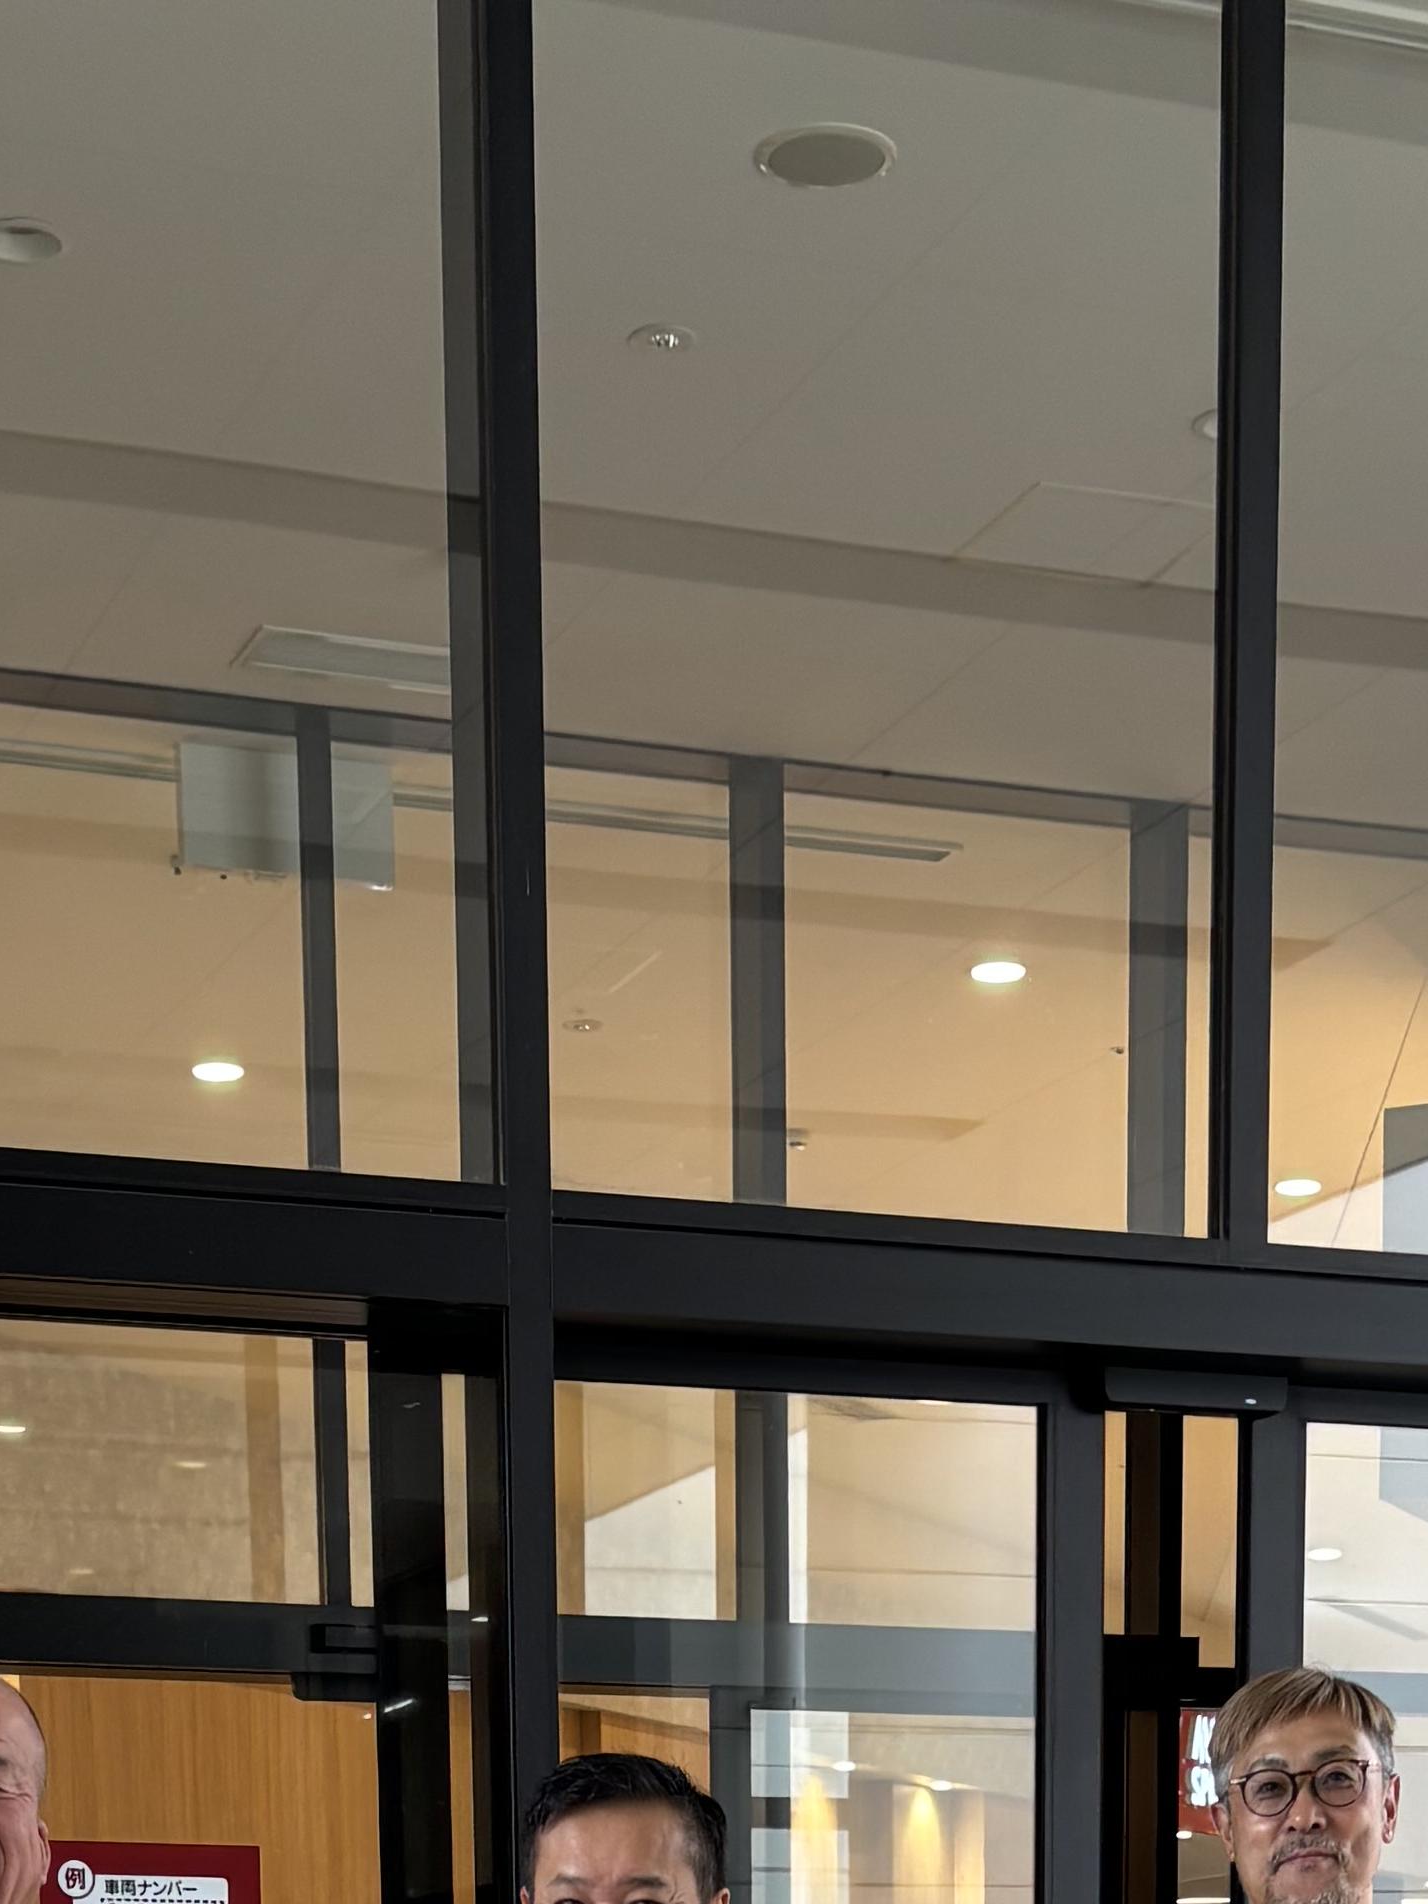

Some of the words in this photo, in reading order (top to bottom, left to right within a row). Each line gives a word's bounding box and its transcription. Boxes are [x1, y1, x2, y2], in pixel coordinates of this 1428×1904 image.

[65, 1867, 87, 1890] 例
[104, 1878, 198, 1897] 車両ナンバー
